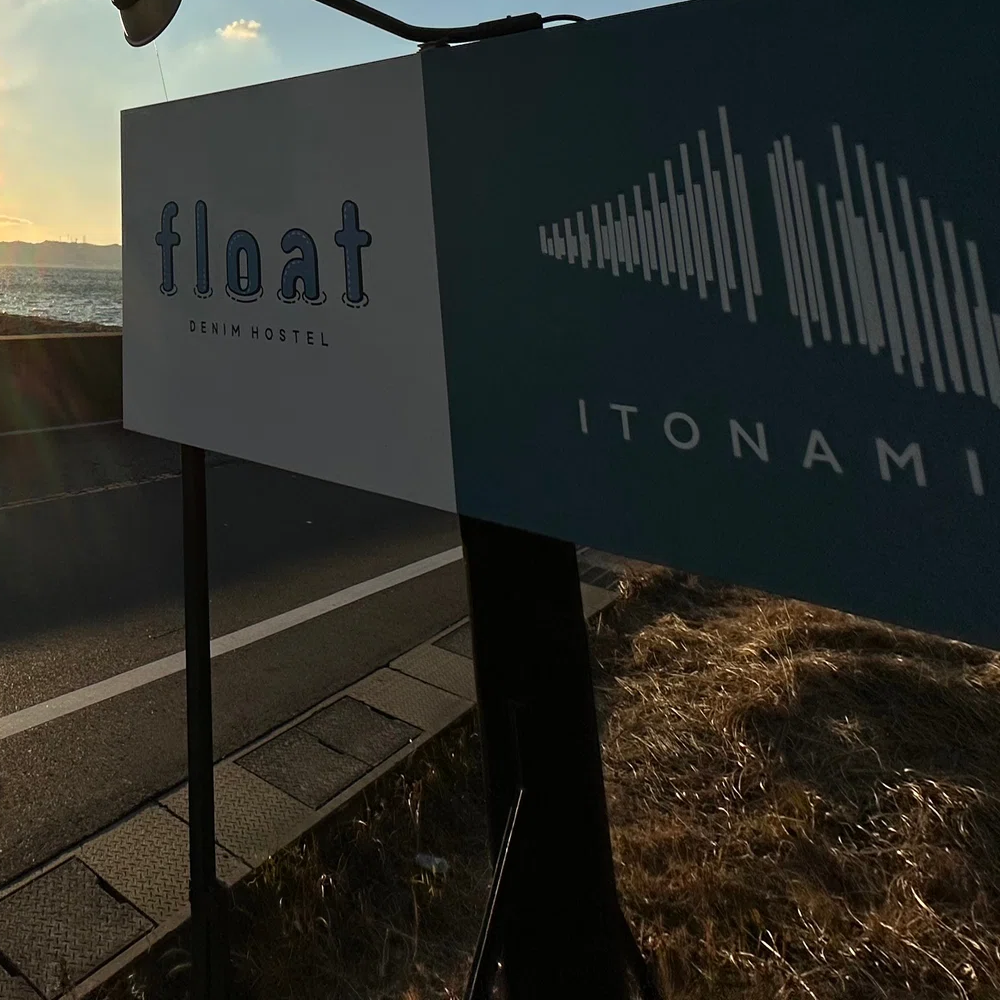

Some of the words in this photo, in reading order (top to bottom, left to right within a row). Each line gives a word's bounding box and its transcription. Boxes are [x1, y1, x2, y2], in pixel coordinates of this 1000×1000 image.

[155, 199, 372, 304] float
[189, 319, 242, 337] DENIM
[251, 326, 330, 347] HOSTEL
[578, 398, 985, 496] ITONAMI
